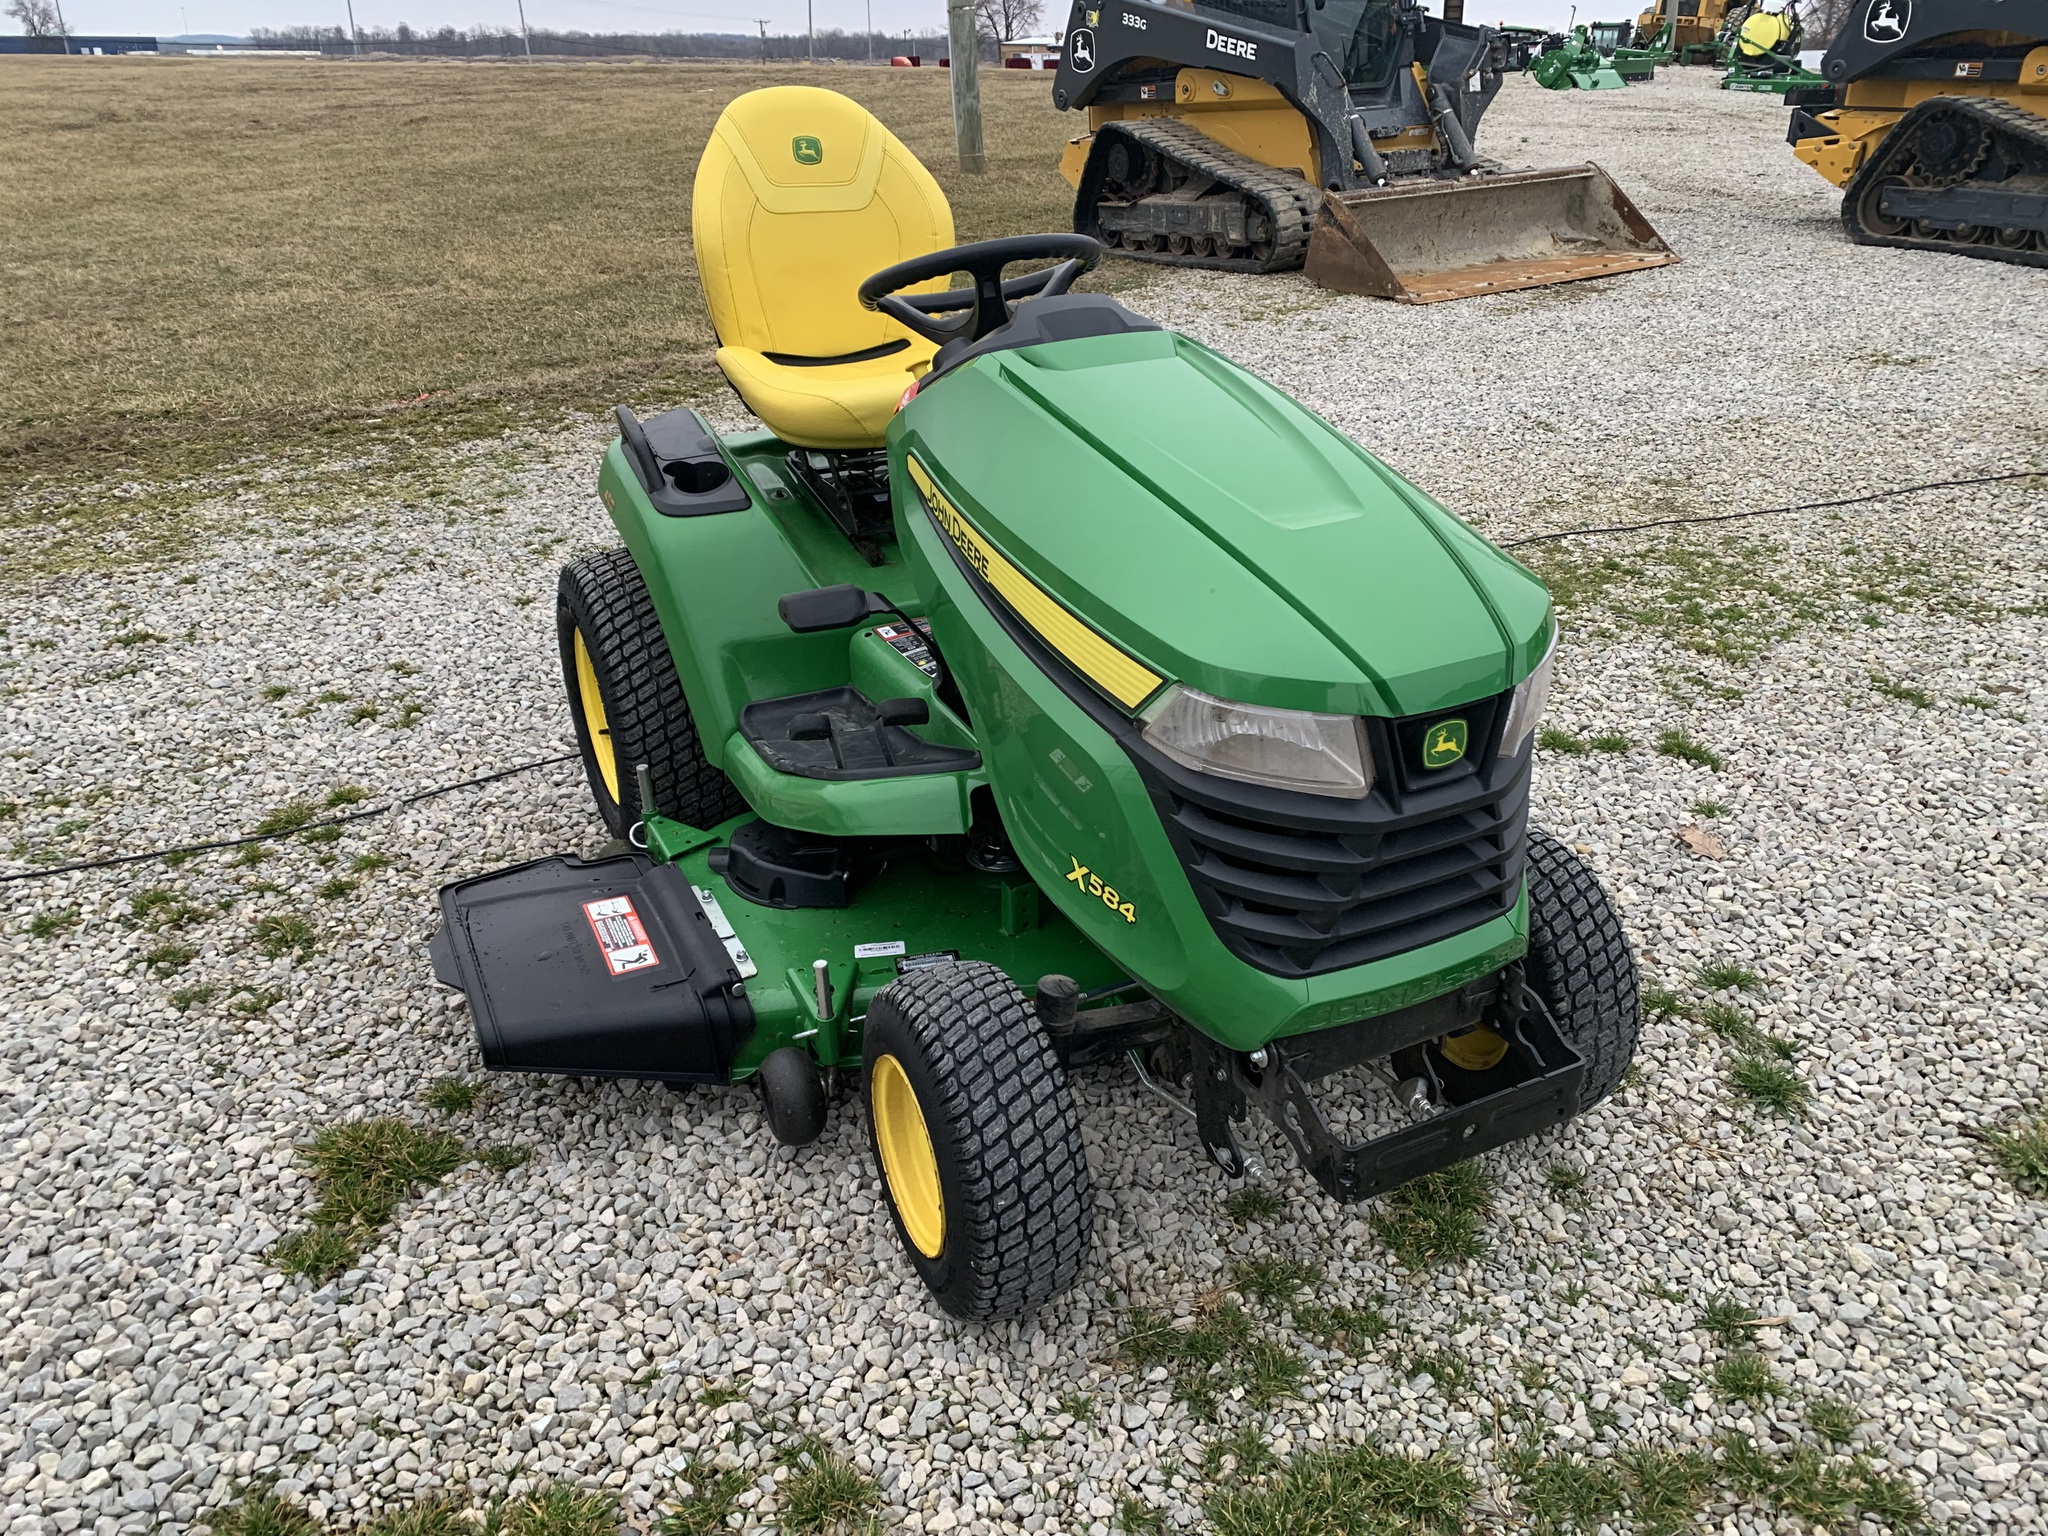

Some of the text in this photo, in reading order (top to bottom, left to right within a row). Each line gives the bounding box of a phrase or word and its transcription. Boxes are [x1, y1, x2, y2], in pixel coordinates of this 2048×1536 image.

[1122, 12, 1147, 30] 333G
[1206, 29, 1257, 60] DEERE
[926, 483, 989, 579] JOHN DEERE
[1064, 853, 1137, 925] X584
[1308, 985, 1408, 1029] JOHN
